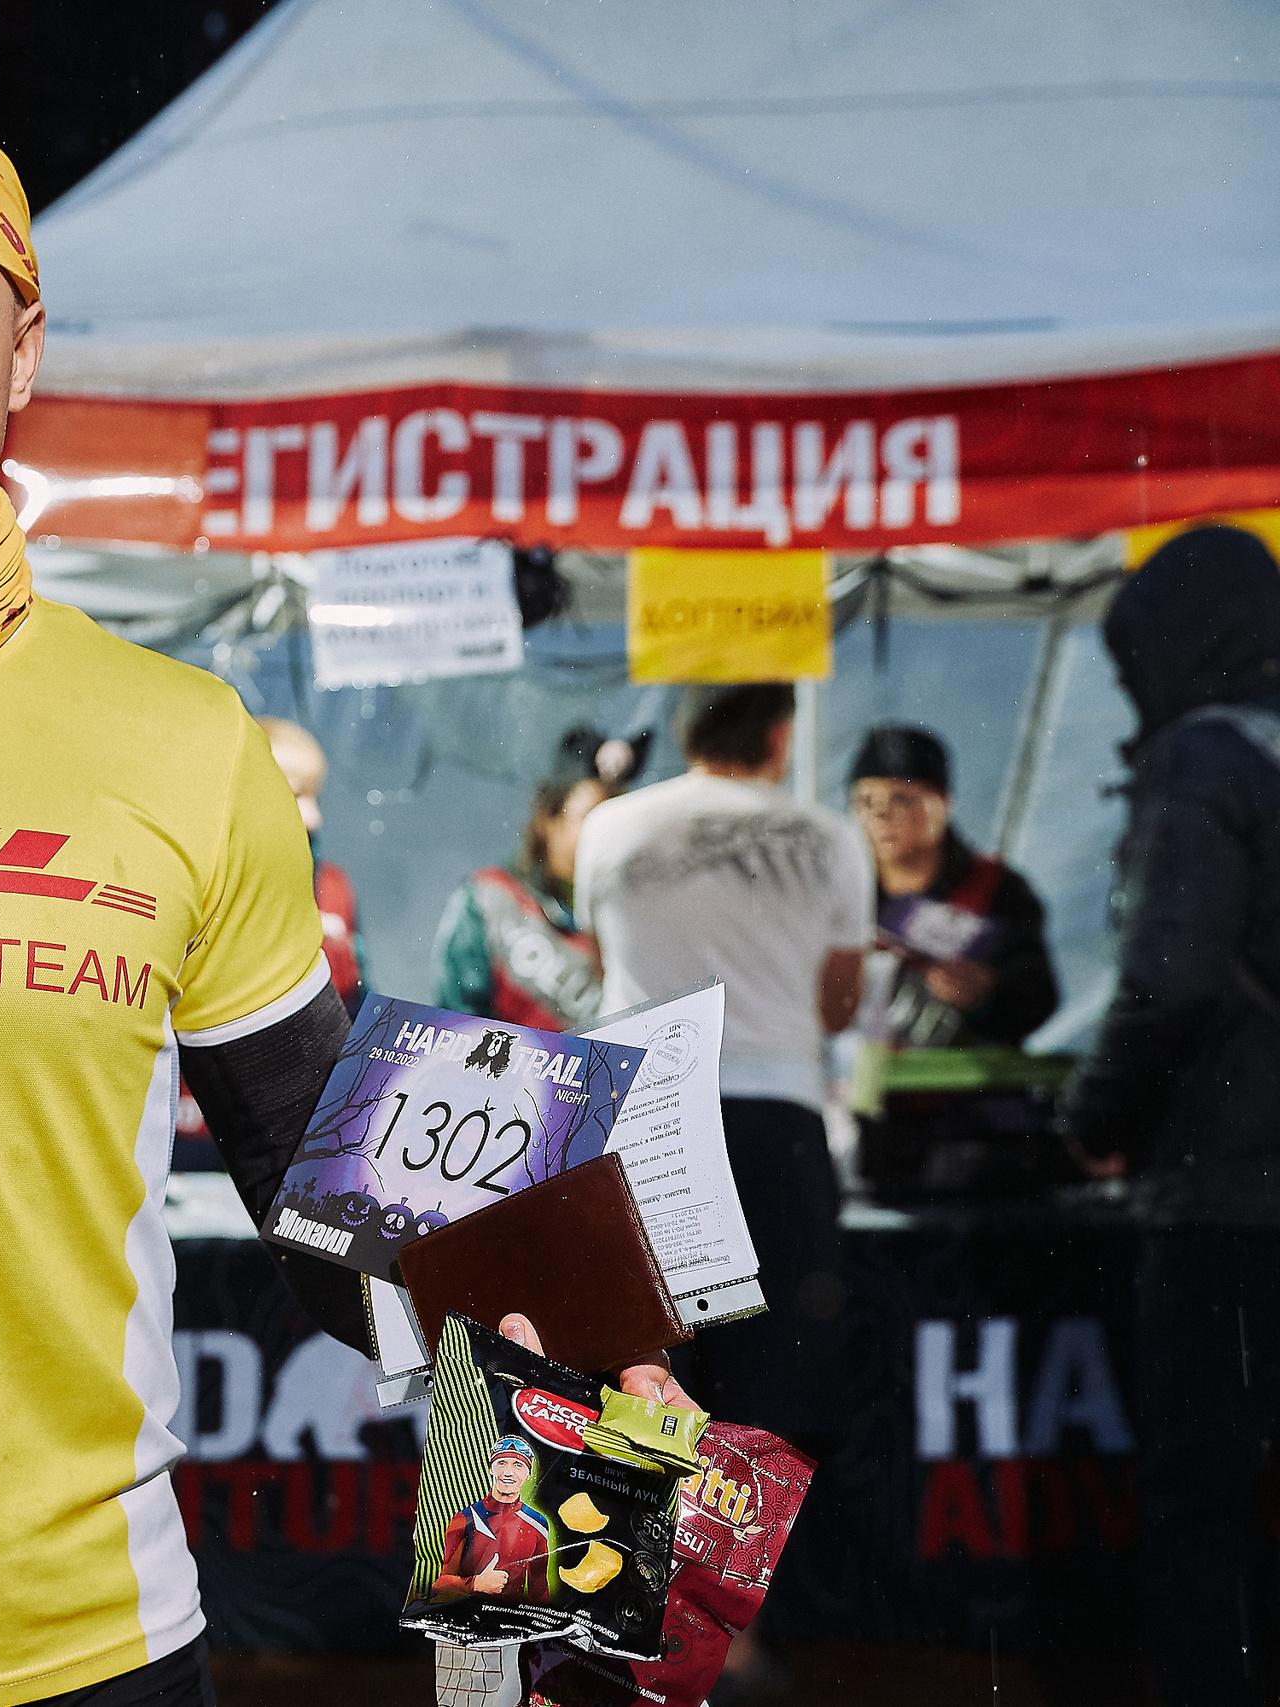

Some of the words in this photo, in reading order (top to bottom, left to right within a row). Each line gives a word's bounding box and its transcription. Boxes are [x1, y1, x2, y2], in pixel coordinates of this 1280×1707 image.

[368, 1046, 420, 1069] 29.10.2022
[393, 1020, 472, 1066] HARD
[511, 1044, 585, 1088] TRAIL
[554, 1088, 590, 1107] NIGHT
[373, 1093, 533, 1196] 1302
[272, 1207, 355, 1258] Михаил
[569, 1467, 630, 1495] ЗЕЛЕНЫЙ
[635, 1489, 659, 1504] ЛУК
[604, 1466, 627, 1479] ВКУС
